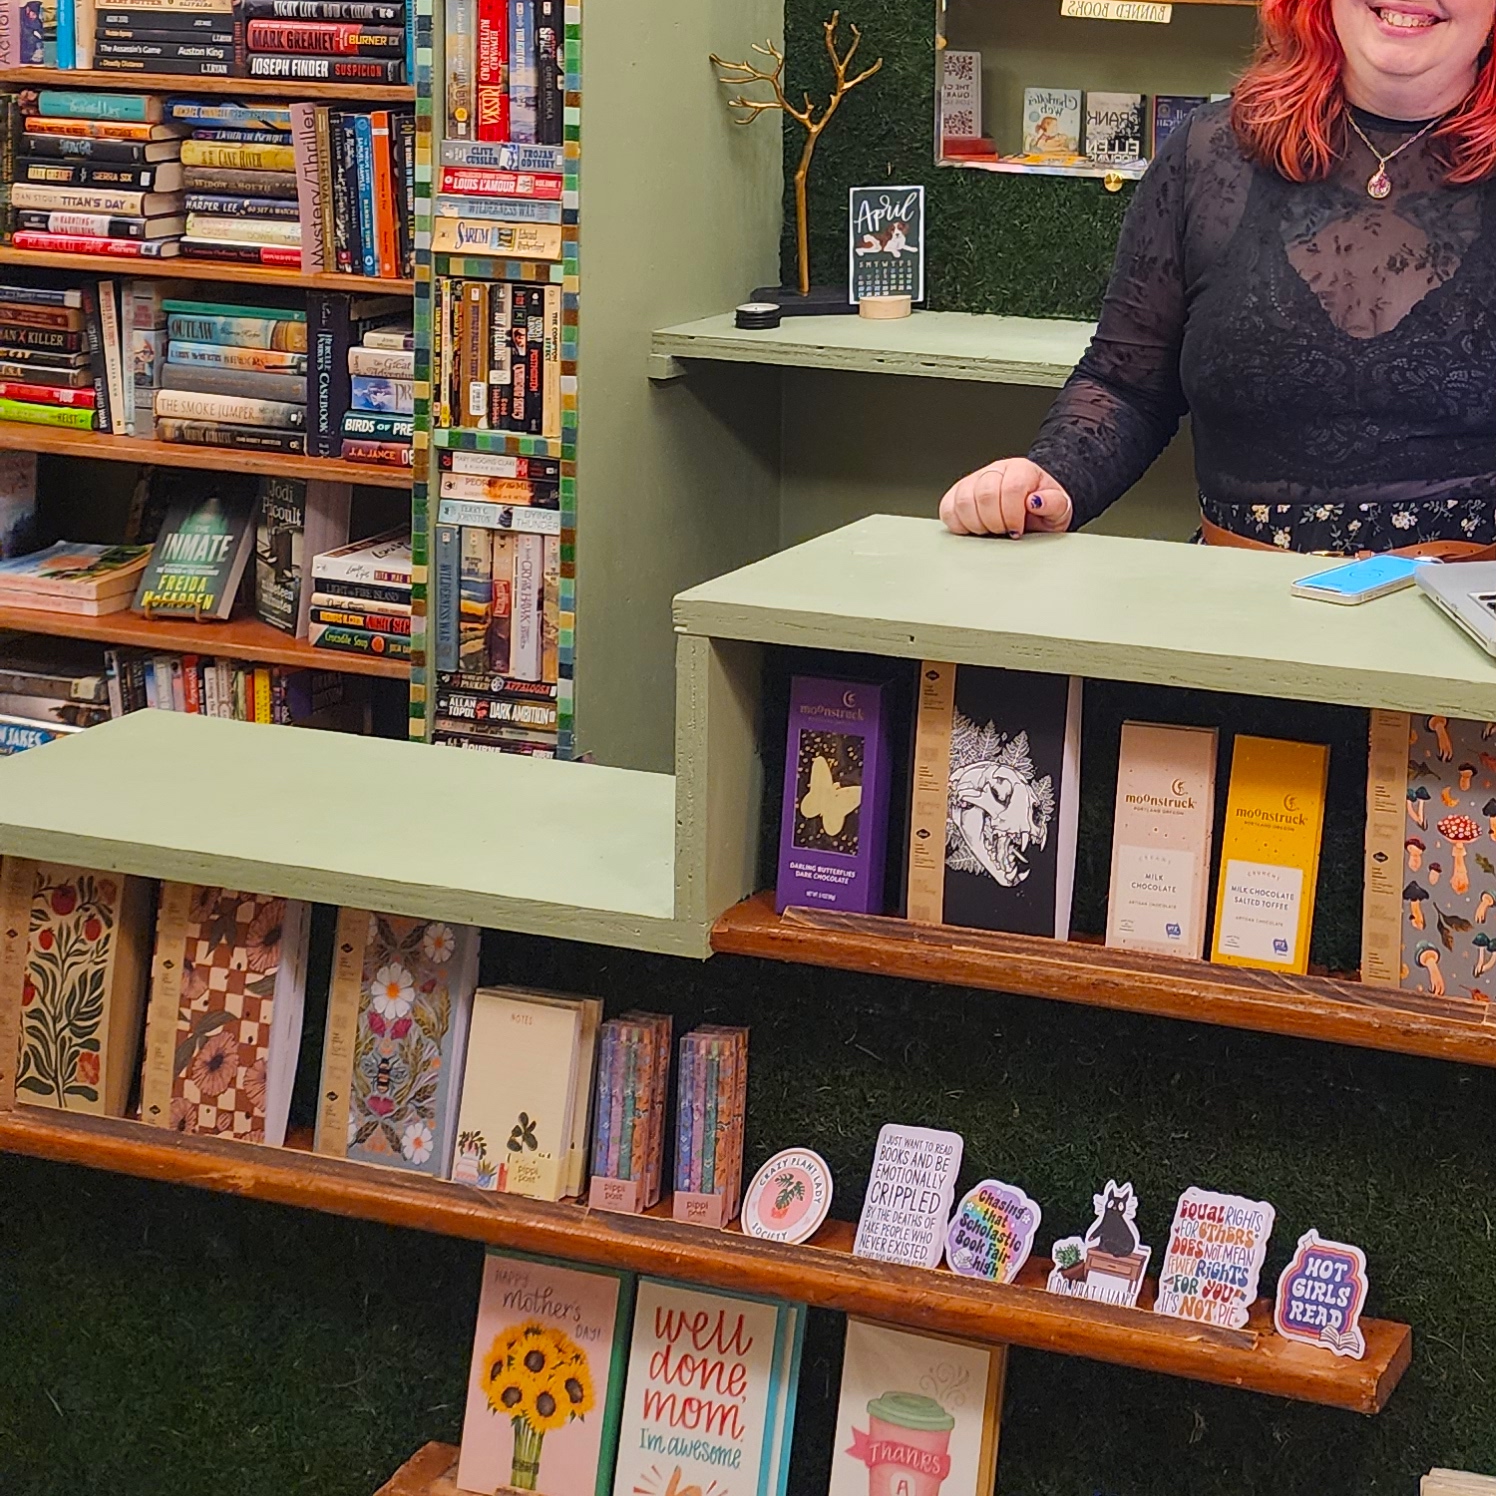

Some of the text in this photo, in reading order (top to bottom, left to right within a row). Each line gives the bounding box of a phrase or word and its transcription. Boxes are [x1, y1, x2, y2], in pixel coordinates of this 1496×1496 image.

[252, 30, 336, 51] MARK GREANEY
[349, 35, 388, 46] BURNER
[251, 58, 382, 78] JOSEPH FINDER SUSPICION
[466, 155, 499, 165] CUSSLER
[471, 147, 494, 156] CLIVE
[523, 149, 554, 159] TROJAN
[521, 158, 555, 169] ODYSSEY
[300, 108, 324, 266] Mystery/Thriller
[453, 177, 516, 193] LOUIS L'AMOUR
[60, 196, 127, 210] TITAN'S DAY
[185, 200, 238, 213] HARPER LEE
[853, 191, 918, 233] April
[27, 332, 64, 346] KILLER
[171, 321, 215, 339] OUTLAW
[160, 398, 254, 420] THE SMOKE JUMPER
[345, 418, 374, 432] BIRDS
[270, 479, 294, 503] Jodi
[262, 496, 302, 525] Picoult
[159, 533, 234, 564] INMATE
[157, 575, 209, 593] FREIDA
[324, 630, 369, 650] Crocodile Soup
[448, 707, 476, 719] TOPOL
[449, 696, 476, 708] ALLAN
[489, 701, 550, 725] DARK AMBITION
[1125, 793, 1196, 810] moonstruck
[1235, 807, 1306, 826] moonstruck
[1131, 882, 1177, 893] CHOCOLATE
[1145, 873, 1164, 881] MILK
[1231, 885, 1295, 901] MILK CHOCOLATE
[1234, 896, 1289, 911] SALTED TOFFEE
[510, 1011, 534, 1027] NOTES
[886, 1135, 903, 1146] JUST
[904, 1137, 924, 1150] WANT
[925, 1141, 934, 1153] TO
[934, 1143, 954, 1156] READ
[879, 1145, 951, 1172] BOOKS AND BE
[759, 1157, 823, 1204] CRAZY PLANT LADY
[875, 1163, 947, 1190] EMOTIONALLY
[870, 1181, 941, 1215] CRIPPLED
[978, 1189, 1028, 1221] Chasing
[865, 1205, 937, 1230] BY THE DEATHS OF
[982, 1208, 1009, 1229] that
[1180, 1218, 1199, 1237] FOR
[1224, 1206, 1264, 1233] RIGHTS
[752, 1222, 788, 1241] SOCIETY
[862, 1219, 933, 1244] FAKE PEOPLE WHO
[959, 1212, 1022, 1252] Scholastic
[859, 1234, 929, 1261] NEVER EXISTED.
[955, 1229, 1011, 1265] Book Fair
[1170, 1235, 1256, 1267] DOES NOT MEAN
[972, 1255, 999, 1278] high
[1167, 1255, 1198, 1276] FEWER
[1304, 1257, 1349, 1283] HOT
[494, 1266, 530, 1292] HAPPY
[1173, 1273, 1199, 1295] FOR
[1291, 1277, 1352, 1308] GIRLS
[1179, 1295, 1217, 1322] NOT
[1288, 1299, 1343, 1329] READ
[576, 1322, 601, 1343] DAY!
[656, 1305, 754, 1357] well
[649, 1343, 748, 1404] done,
[643, 1392, 746, 1444] mom.
[639, 1425, 743, 1471] I'm awesome
[868, 1438, 942, 1477] Thanks
